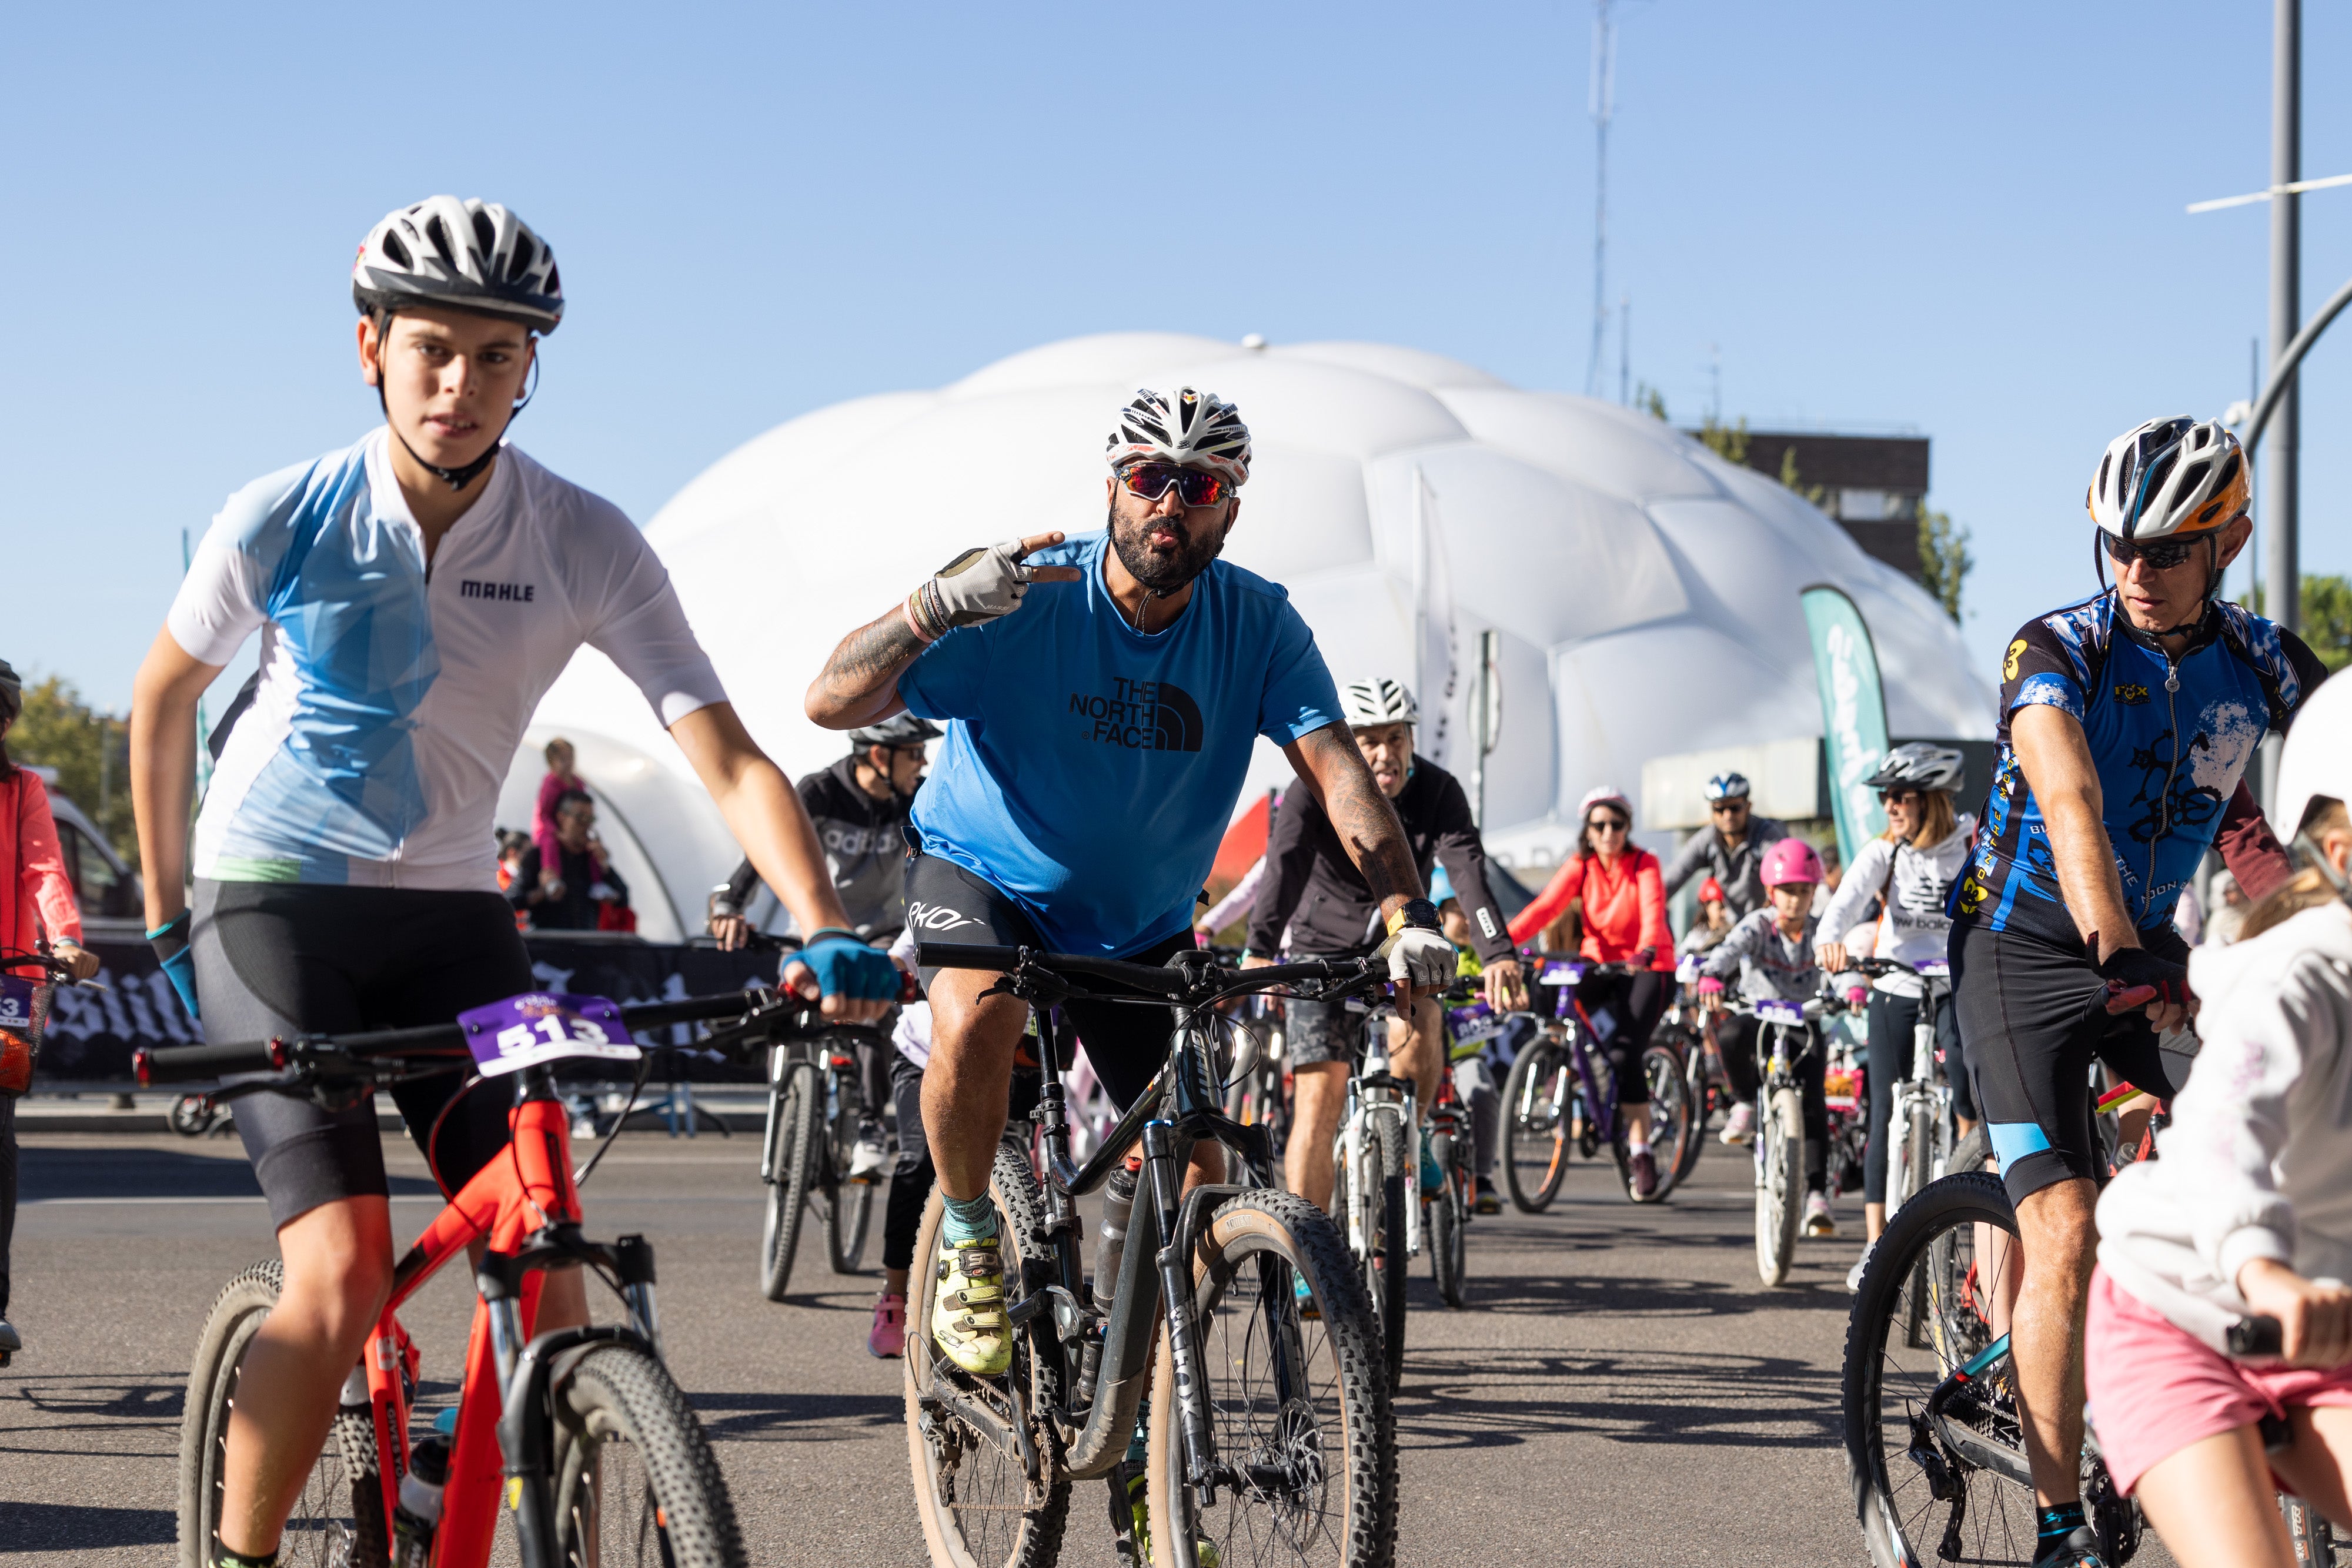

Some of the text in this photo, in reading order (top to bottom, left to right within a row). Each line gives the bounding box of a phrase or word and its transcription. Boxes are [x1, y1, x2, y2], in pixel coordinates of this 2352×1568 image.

[455, 580, 534, 602] MAHLE
[1068, 692, 1155, 727] NORTH
[1113, 677, 1156, 704] THE
[1092, 720, 1154, 750] FACE
[2000, 750, 2017, 799] MOO
[496, 1014, 609, 1057] 513
[1191, 1029, 1210, 1097] GIANT
[1171, 1345, 1203, 1425] FOX
